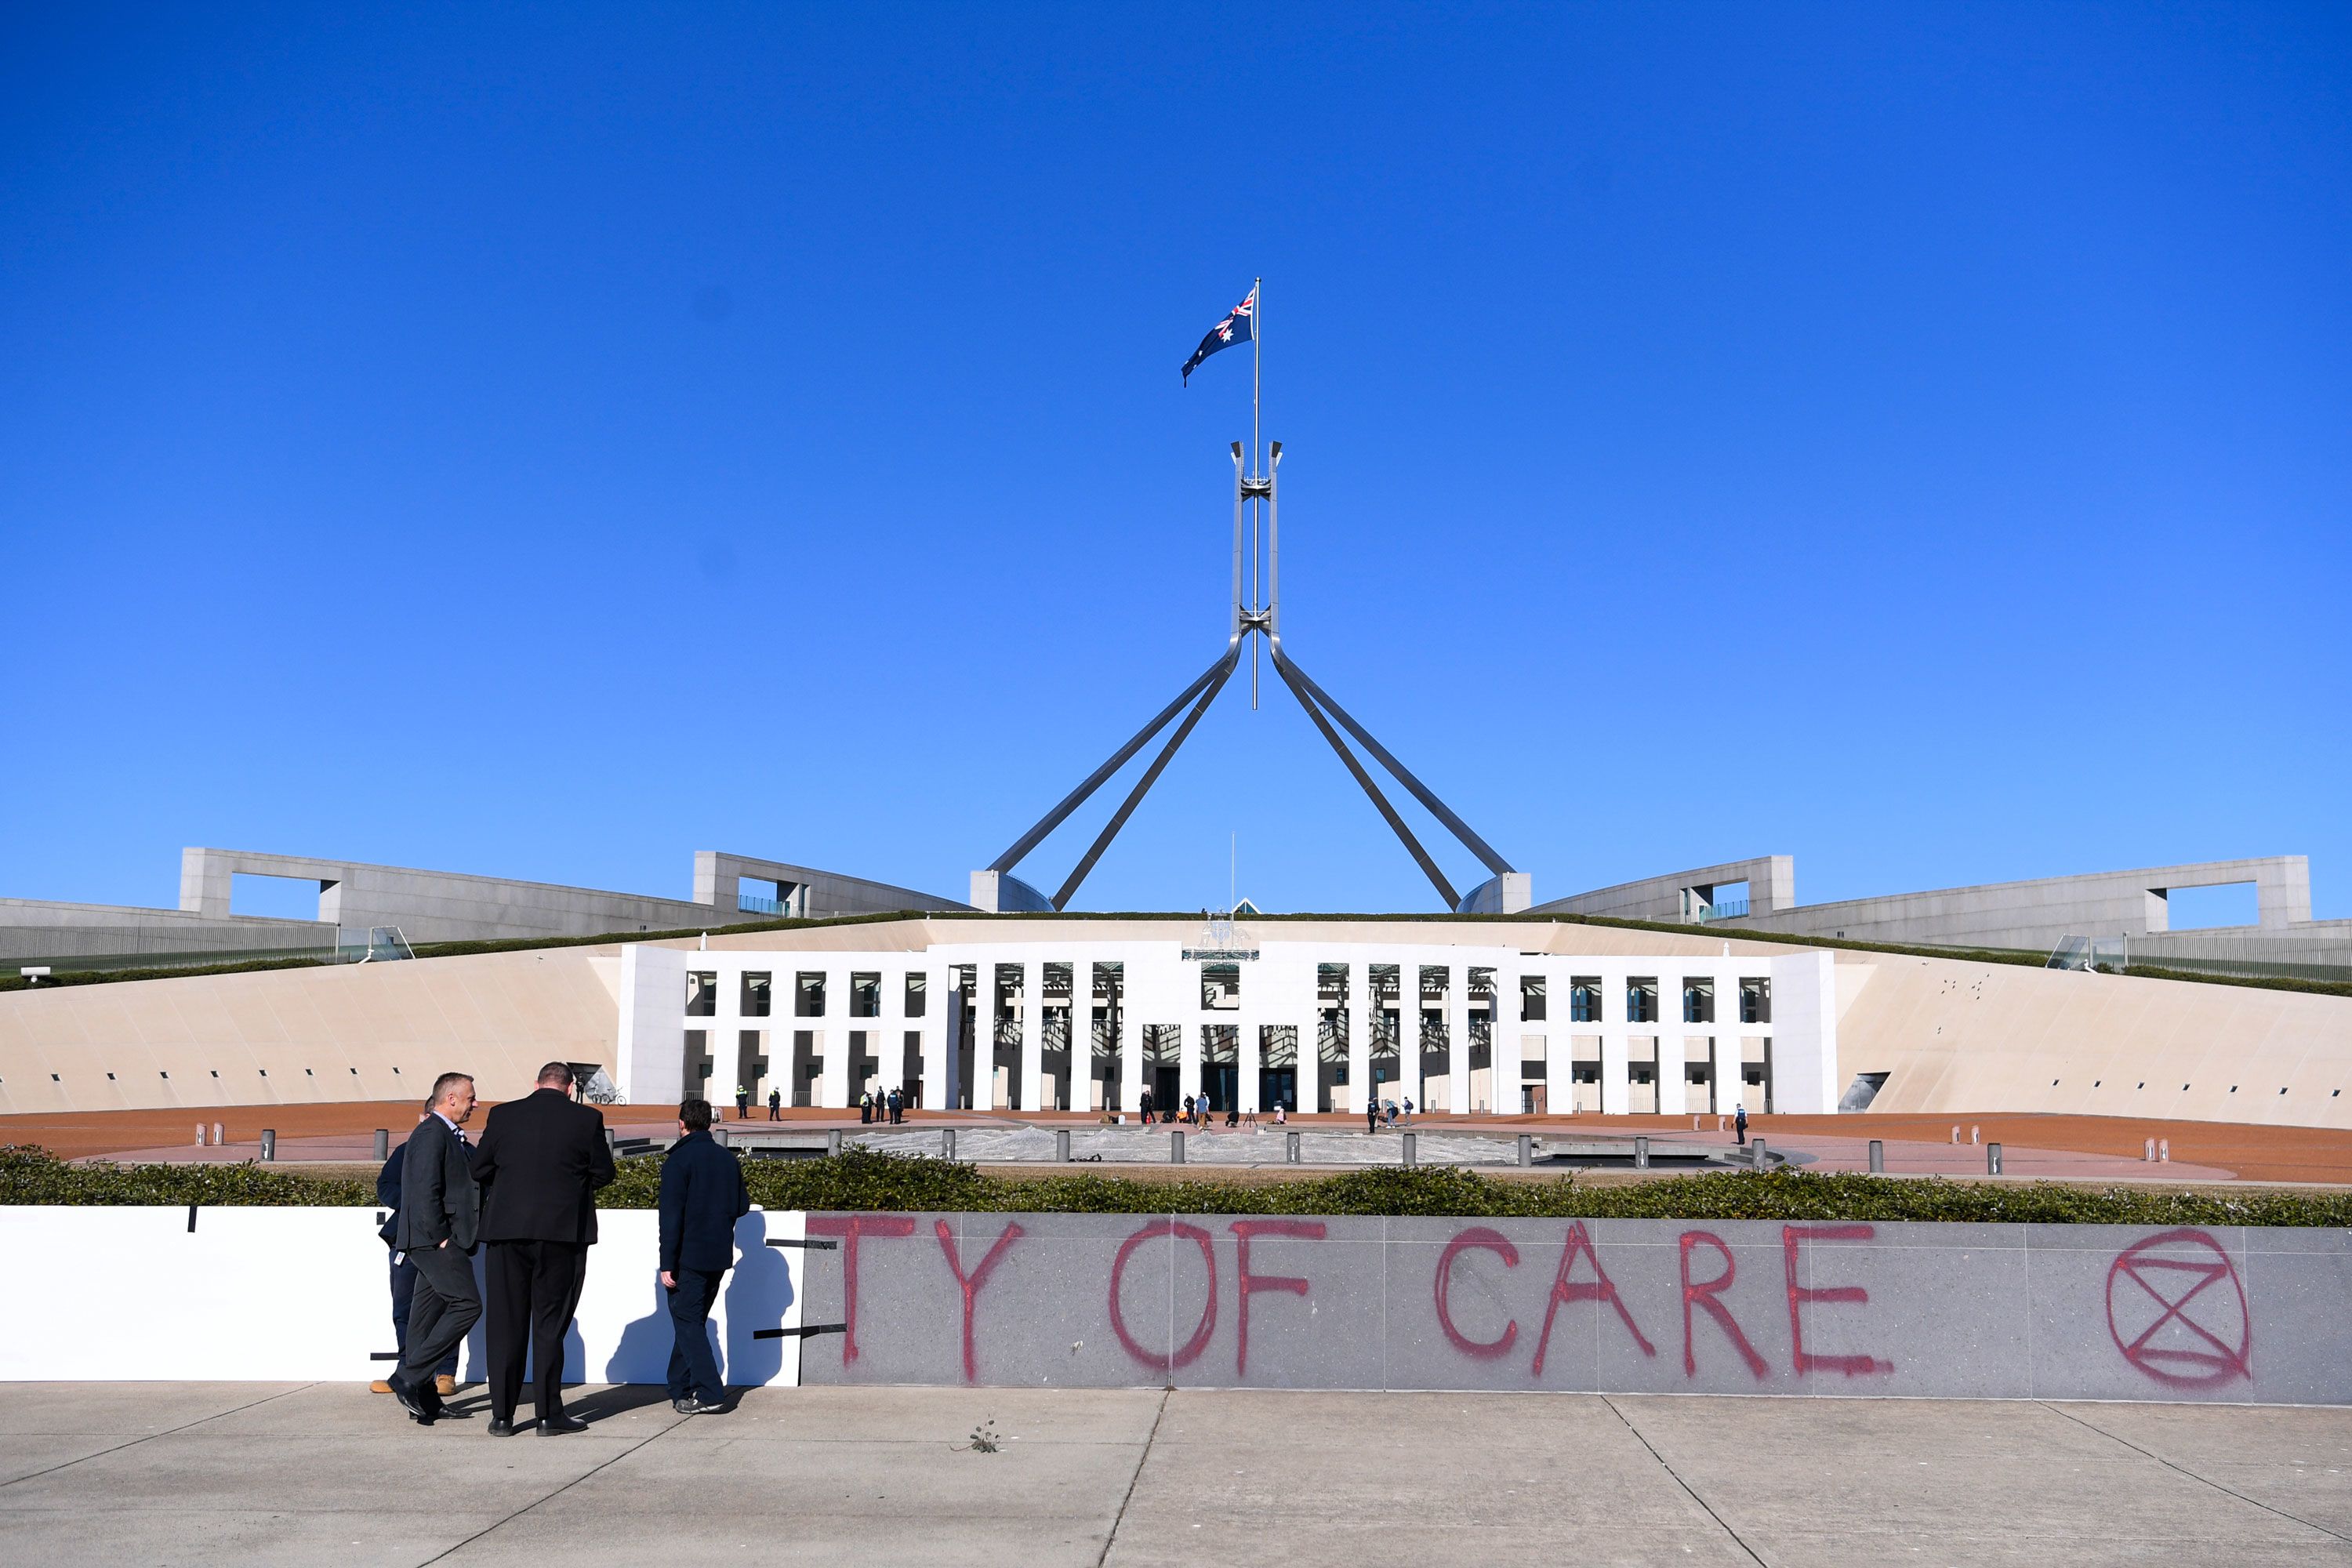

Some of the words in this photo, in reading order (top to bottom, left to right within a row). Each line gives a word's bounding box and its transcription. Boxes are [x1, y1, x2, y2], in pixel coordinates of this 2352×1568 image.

[805, 1215, 1024, 1383] TY
[1108, 1219, 1327, 1377] OF
[1434, 1220, 1894, 1378] CARE
